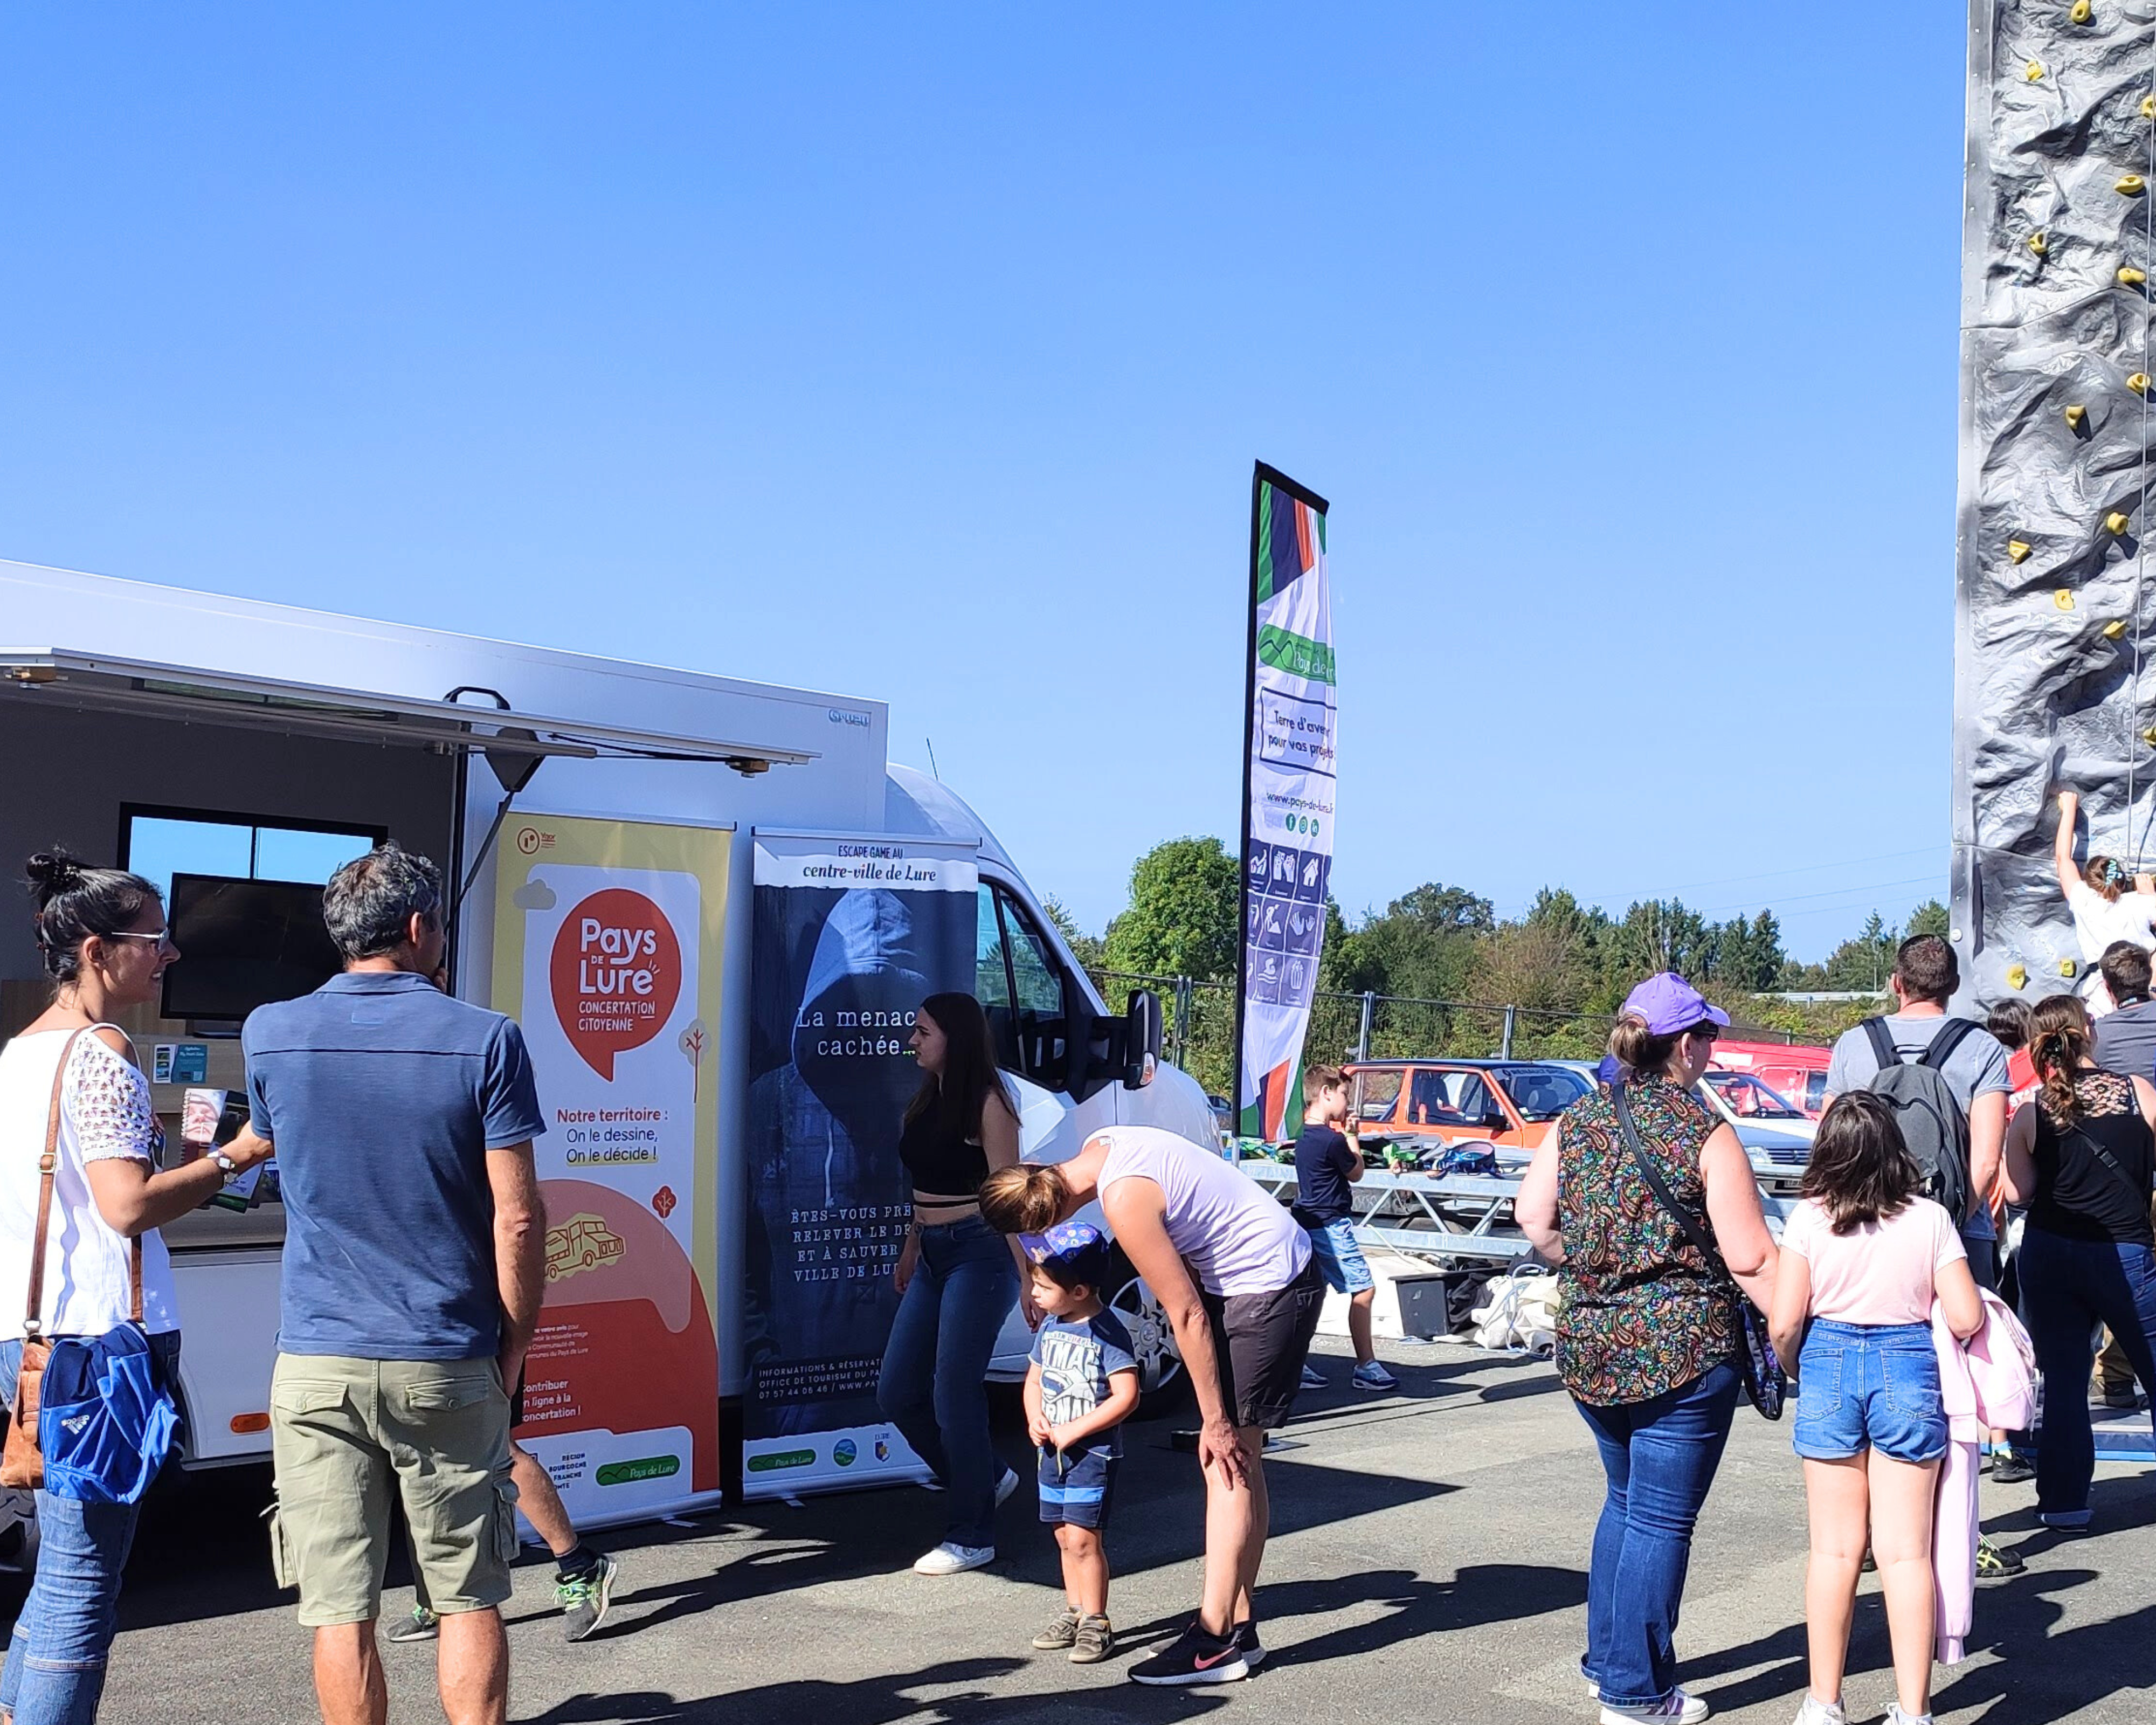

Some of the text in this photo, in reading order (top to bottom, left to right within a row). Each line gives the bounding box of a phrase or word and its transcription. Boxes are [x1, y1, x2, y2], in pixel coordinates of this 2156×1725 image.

[1293, 651, 1311, 673] Pays
[1312, 658, 1326, 674] de
[1274, 710, 1295, 730] Terre
[1268, 735, 1287, 748] pour
[1288, 740, 1308, 752] vos
[838, 845, 903, 859] ESCAPE GAME AU
[803, 862, 936, 881] centre-ville de Lure
[581, 918, 657, 964] Pays
[591, 955, 604, 964] DE
[579, 960, 653, 995] Lure
[798, 1008, 916, 1027] La menac
[557, 1107, 668, 1123] Notre territoire :
[567, 1127, 658, 1142] On le dessine,
[566, 1146, 657, 1163] On le décide !
[884, 1203, 911, 1218] PRÊ
[793, 1222, 911, 1243] RELEVER LE DÉ
[798, 1244, 898, 1262] ET À SAUVER
[794, 1263, 898, 1282] VILLE DE LU
[759, 1363, 826, 1377] INFORMATIONS
[839, 1358, 883, 1369] RÉSERVATI
[759, 1378, 790, 1389] OFFICE
[794, 1377, 804, 1385] DE
[808, 1372, 851, 1383] TOURISME
[855, 1370, 866, 1379] DU
[523, 1392, 571, 1409] n ligne à la
[759, 1391, 770, 1399] 07
[773, 1389, 784, 1398] 57
[788, 1388, 799, 1396] 44
[522, 1407, 576, 1422] oncertation
[554, 1471, 582, 1481] FRANCHE
[630, 1464, 675, 1479] Pays de Lure
